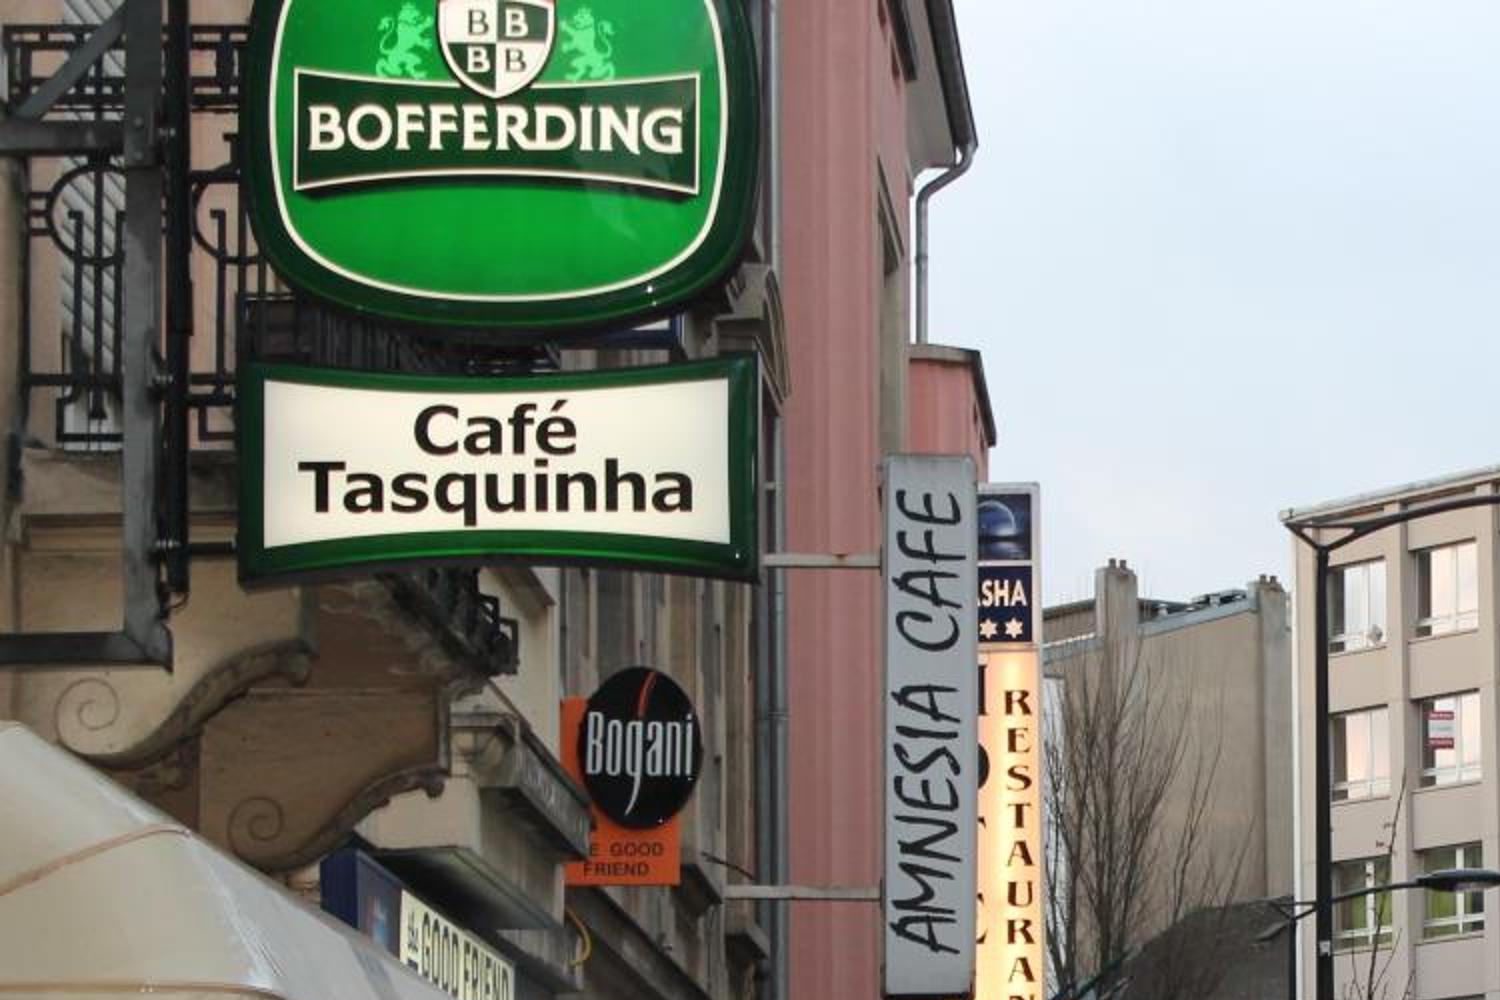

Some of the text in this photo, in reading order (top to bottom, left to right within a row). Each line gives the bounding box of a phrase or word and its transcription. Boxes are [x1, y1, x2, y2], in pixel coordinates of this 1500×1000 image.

[308, 104, 684, 155] BOFFERDING
[413, 400, 577, 454] Café
[298, 459, 693, 525] Tasquinha
[896, 488, 966, 654] CAFE
[978, 579, 1027, 607] SHA
[585, 711, 694, 816] Bogani
[889, 683, 962, 955] AMNESIA
[583, 863, 649, 876] FRIEND
[609, 842, 664, 857] GOOD
[421, 911, 460, 998] GOOD
